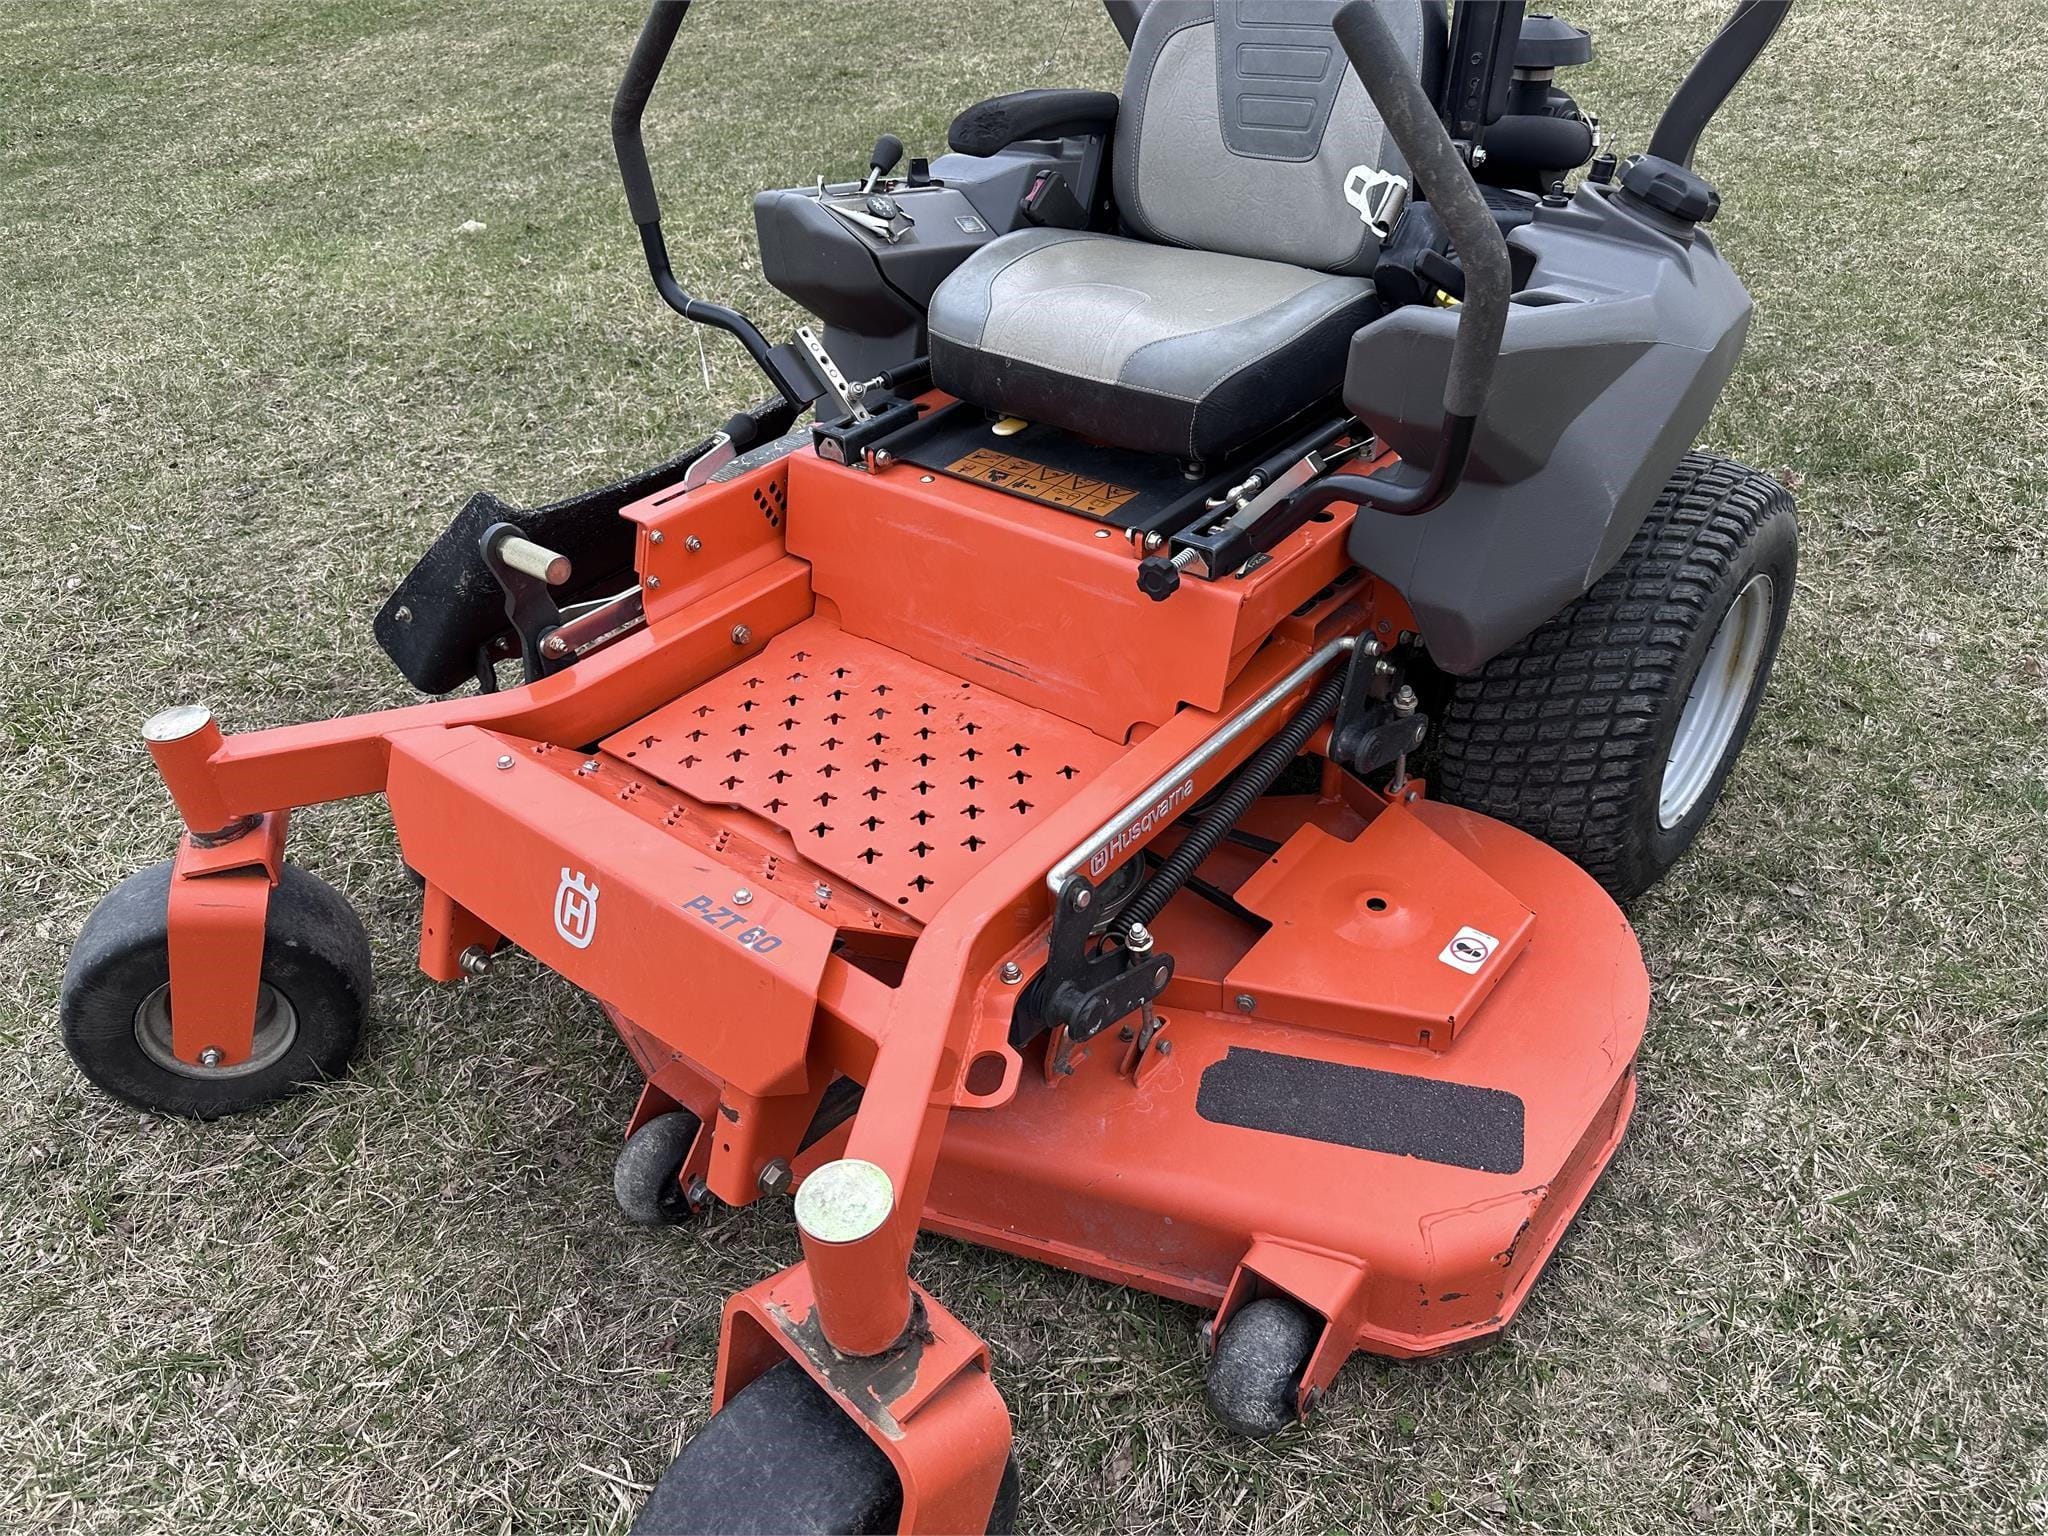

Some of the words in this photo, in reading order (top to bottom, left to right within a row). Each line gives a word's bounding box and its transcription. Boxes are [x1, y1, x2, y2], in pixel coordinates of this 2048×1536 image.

[1110, 779, 1193, 860] Husqvarna
[681, 895, 747, 931] P-ZT
[737, 927, 783, 953] 60
